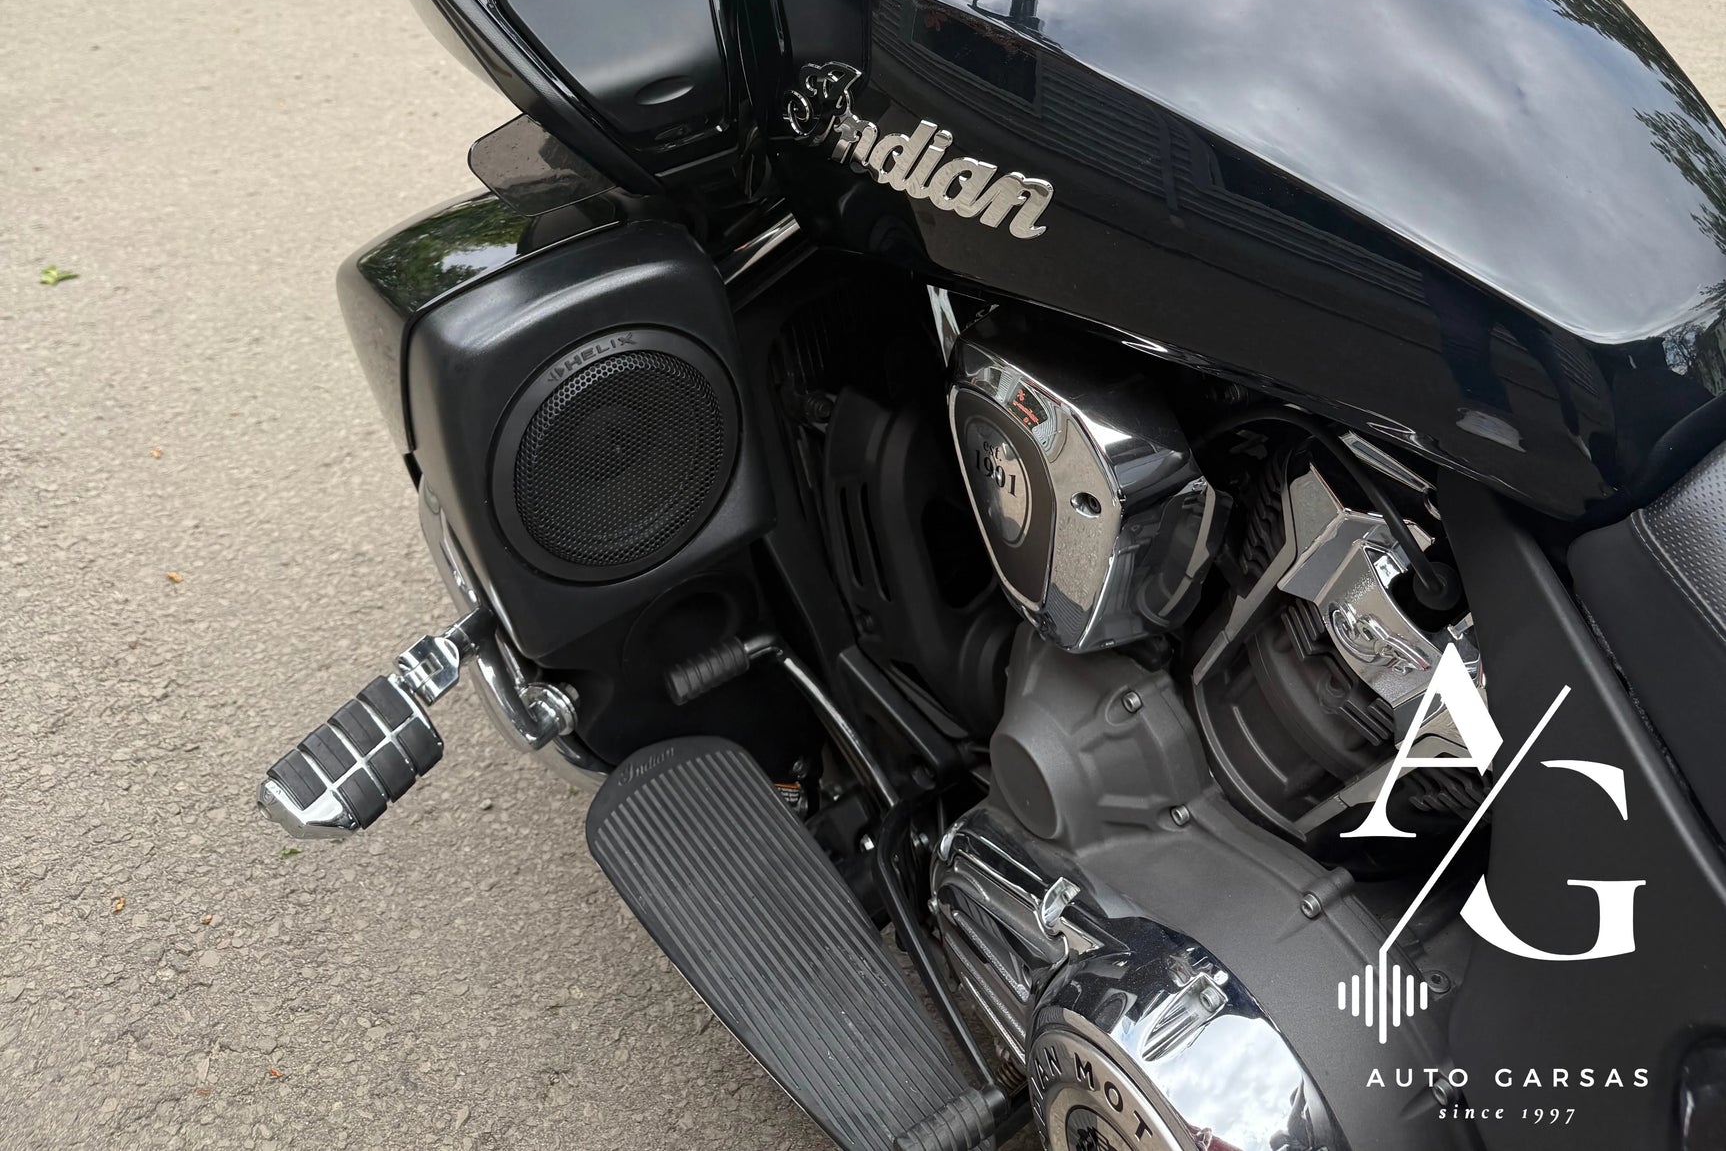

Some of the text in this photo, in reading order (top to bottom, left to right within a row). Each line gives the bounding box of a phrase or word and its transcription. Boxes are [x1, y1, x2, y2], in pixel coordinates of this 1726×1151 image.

[564, 332, 638, 371] HELIX
[983, 441, 1002, 462] est.
[975, 449, 1017, 498] 1901
